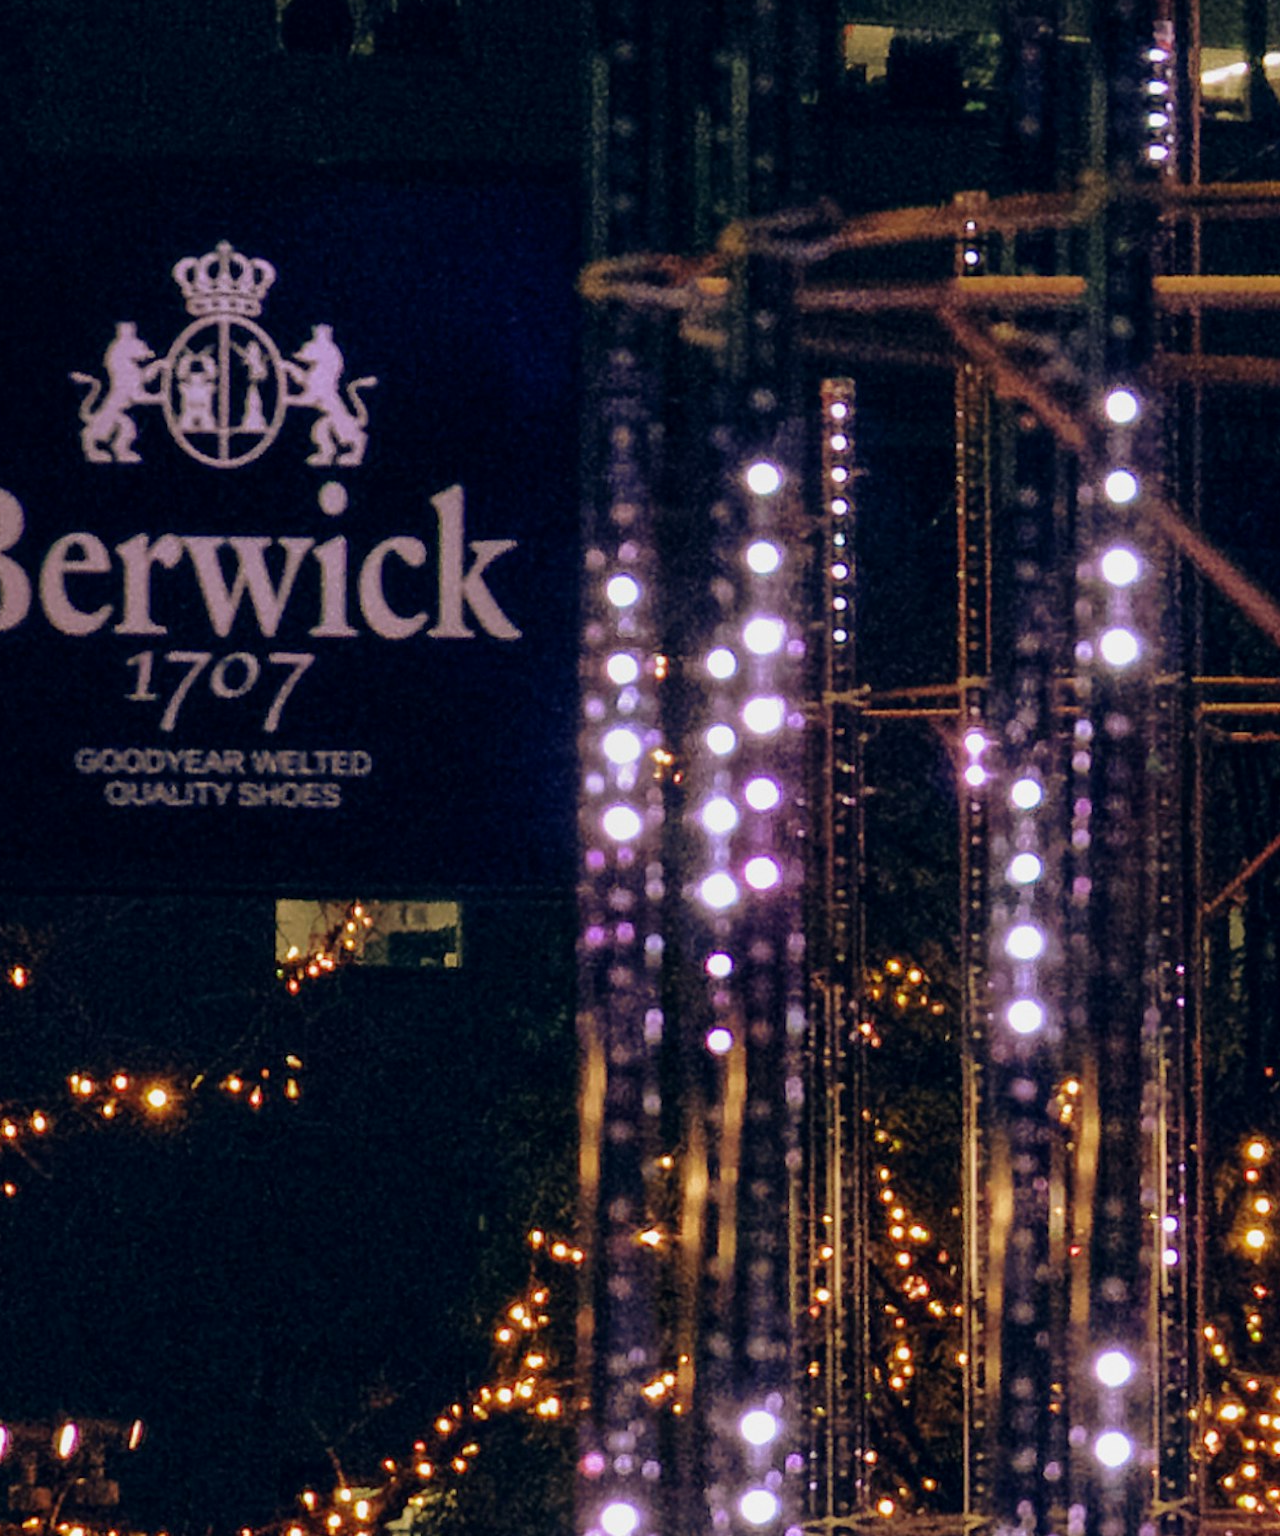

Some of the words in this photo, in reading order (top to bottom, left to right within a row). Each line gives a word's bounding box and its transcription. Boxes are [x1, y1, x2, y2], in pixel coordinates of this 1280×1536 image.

[126, 650, 316, 733] 1707
[75, 749, 245, 774] GOODYEAR
[252, 751, 373, 776] WELTED
[105, 781, 231, 806] QUALITY
[238, 782, 341, 806] SHOES
